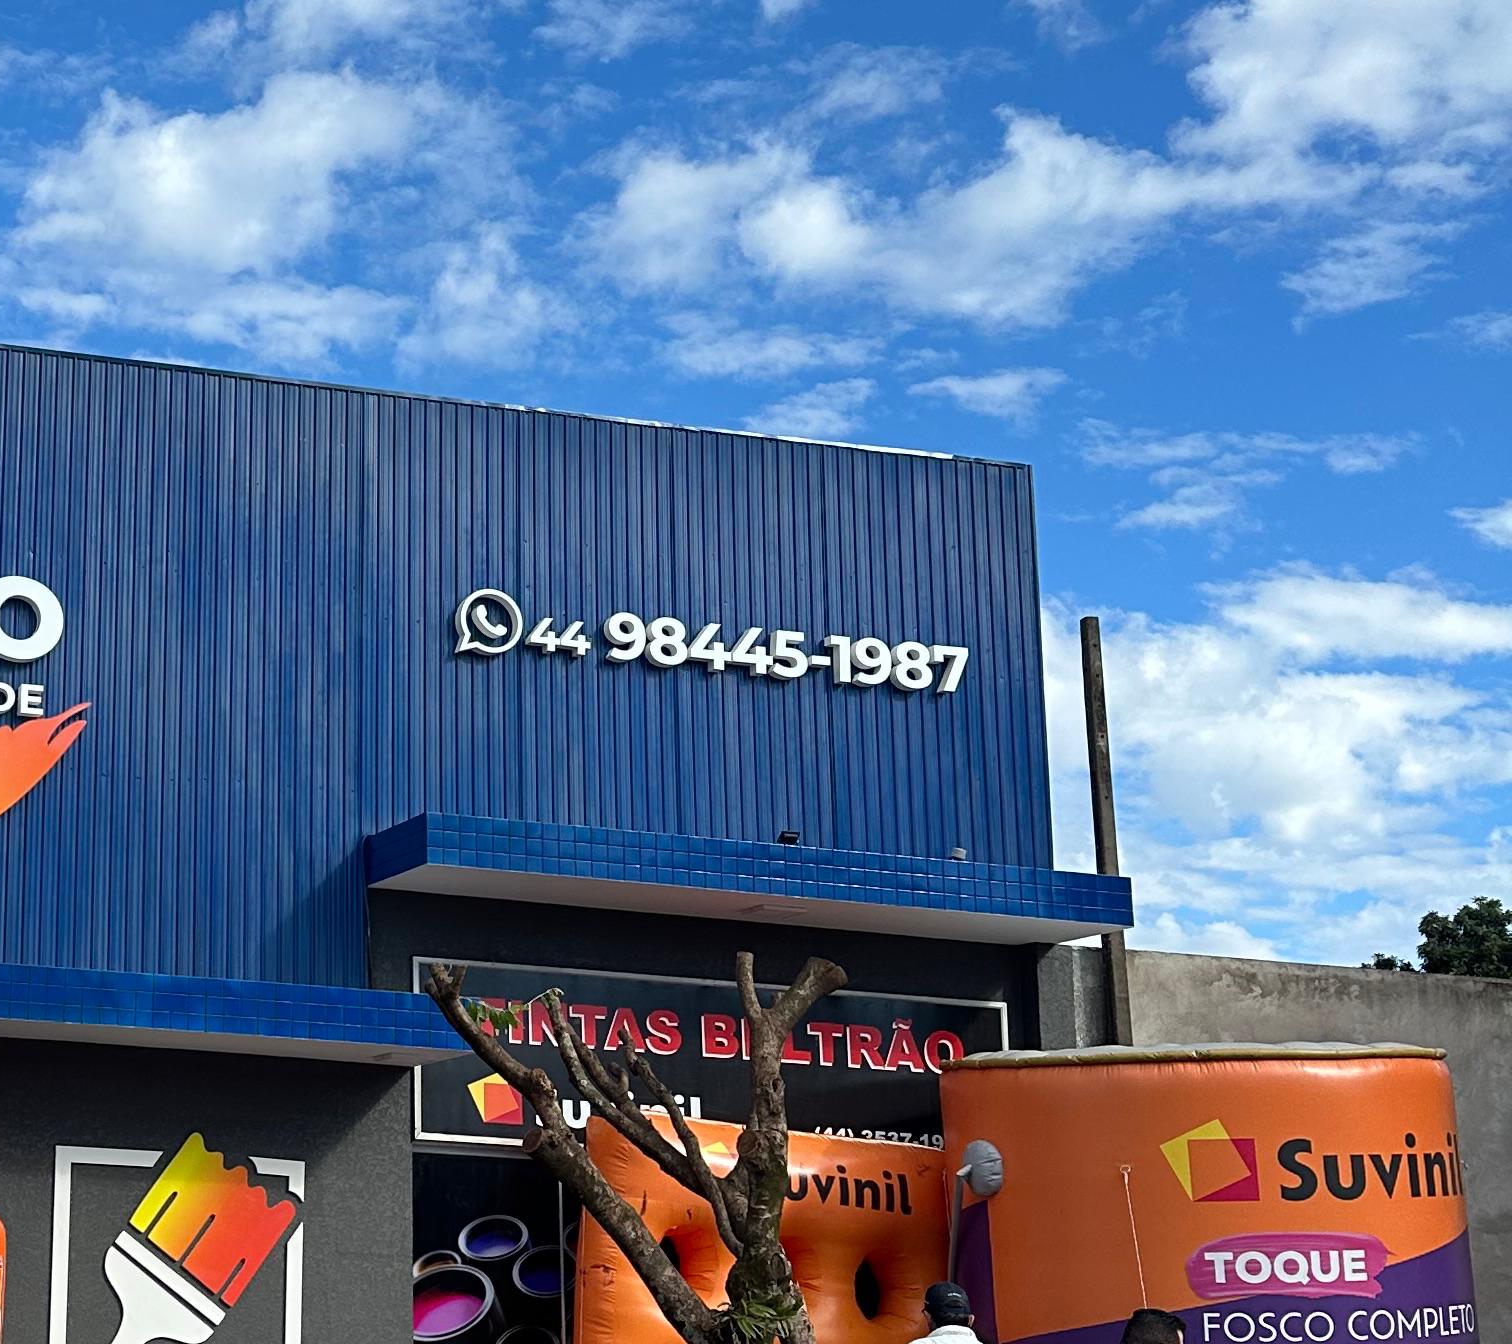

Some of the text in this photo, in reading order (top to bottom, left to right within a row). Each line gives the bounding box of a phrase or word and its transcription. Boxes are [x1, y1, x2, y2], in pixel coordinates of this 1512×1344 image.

[525, 611, 970, 695] 44 98445-1987
[785, 1165, 913, 1216] uvinil
[1277, 1132, 1463, 1202] Suvinil
[1204, 1249, 1368, 1285] TOQUE
[1203, 1303, 1475, 1343] FOSCO COMPLETO
